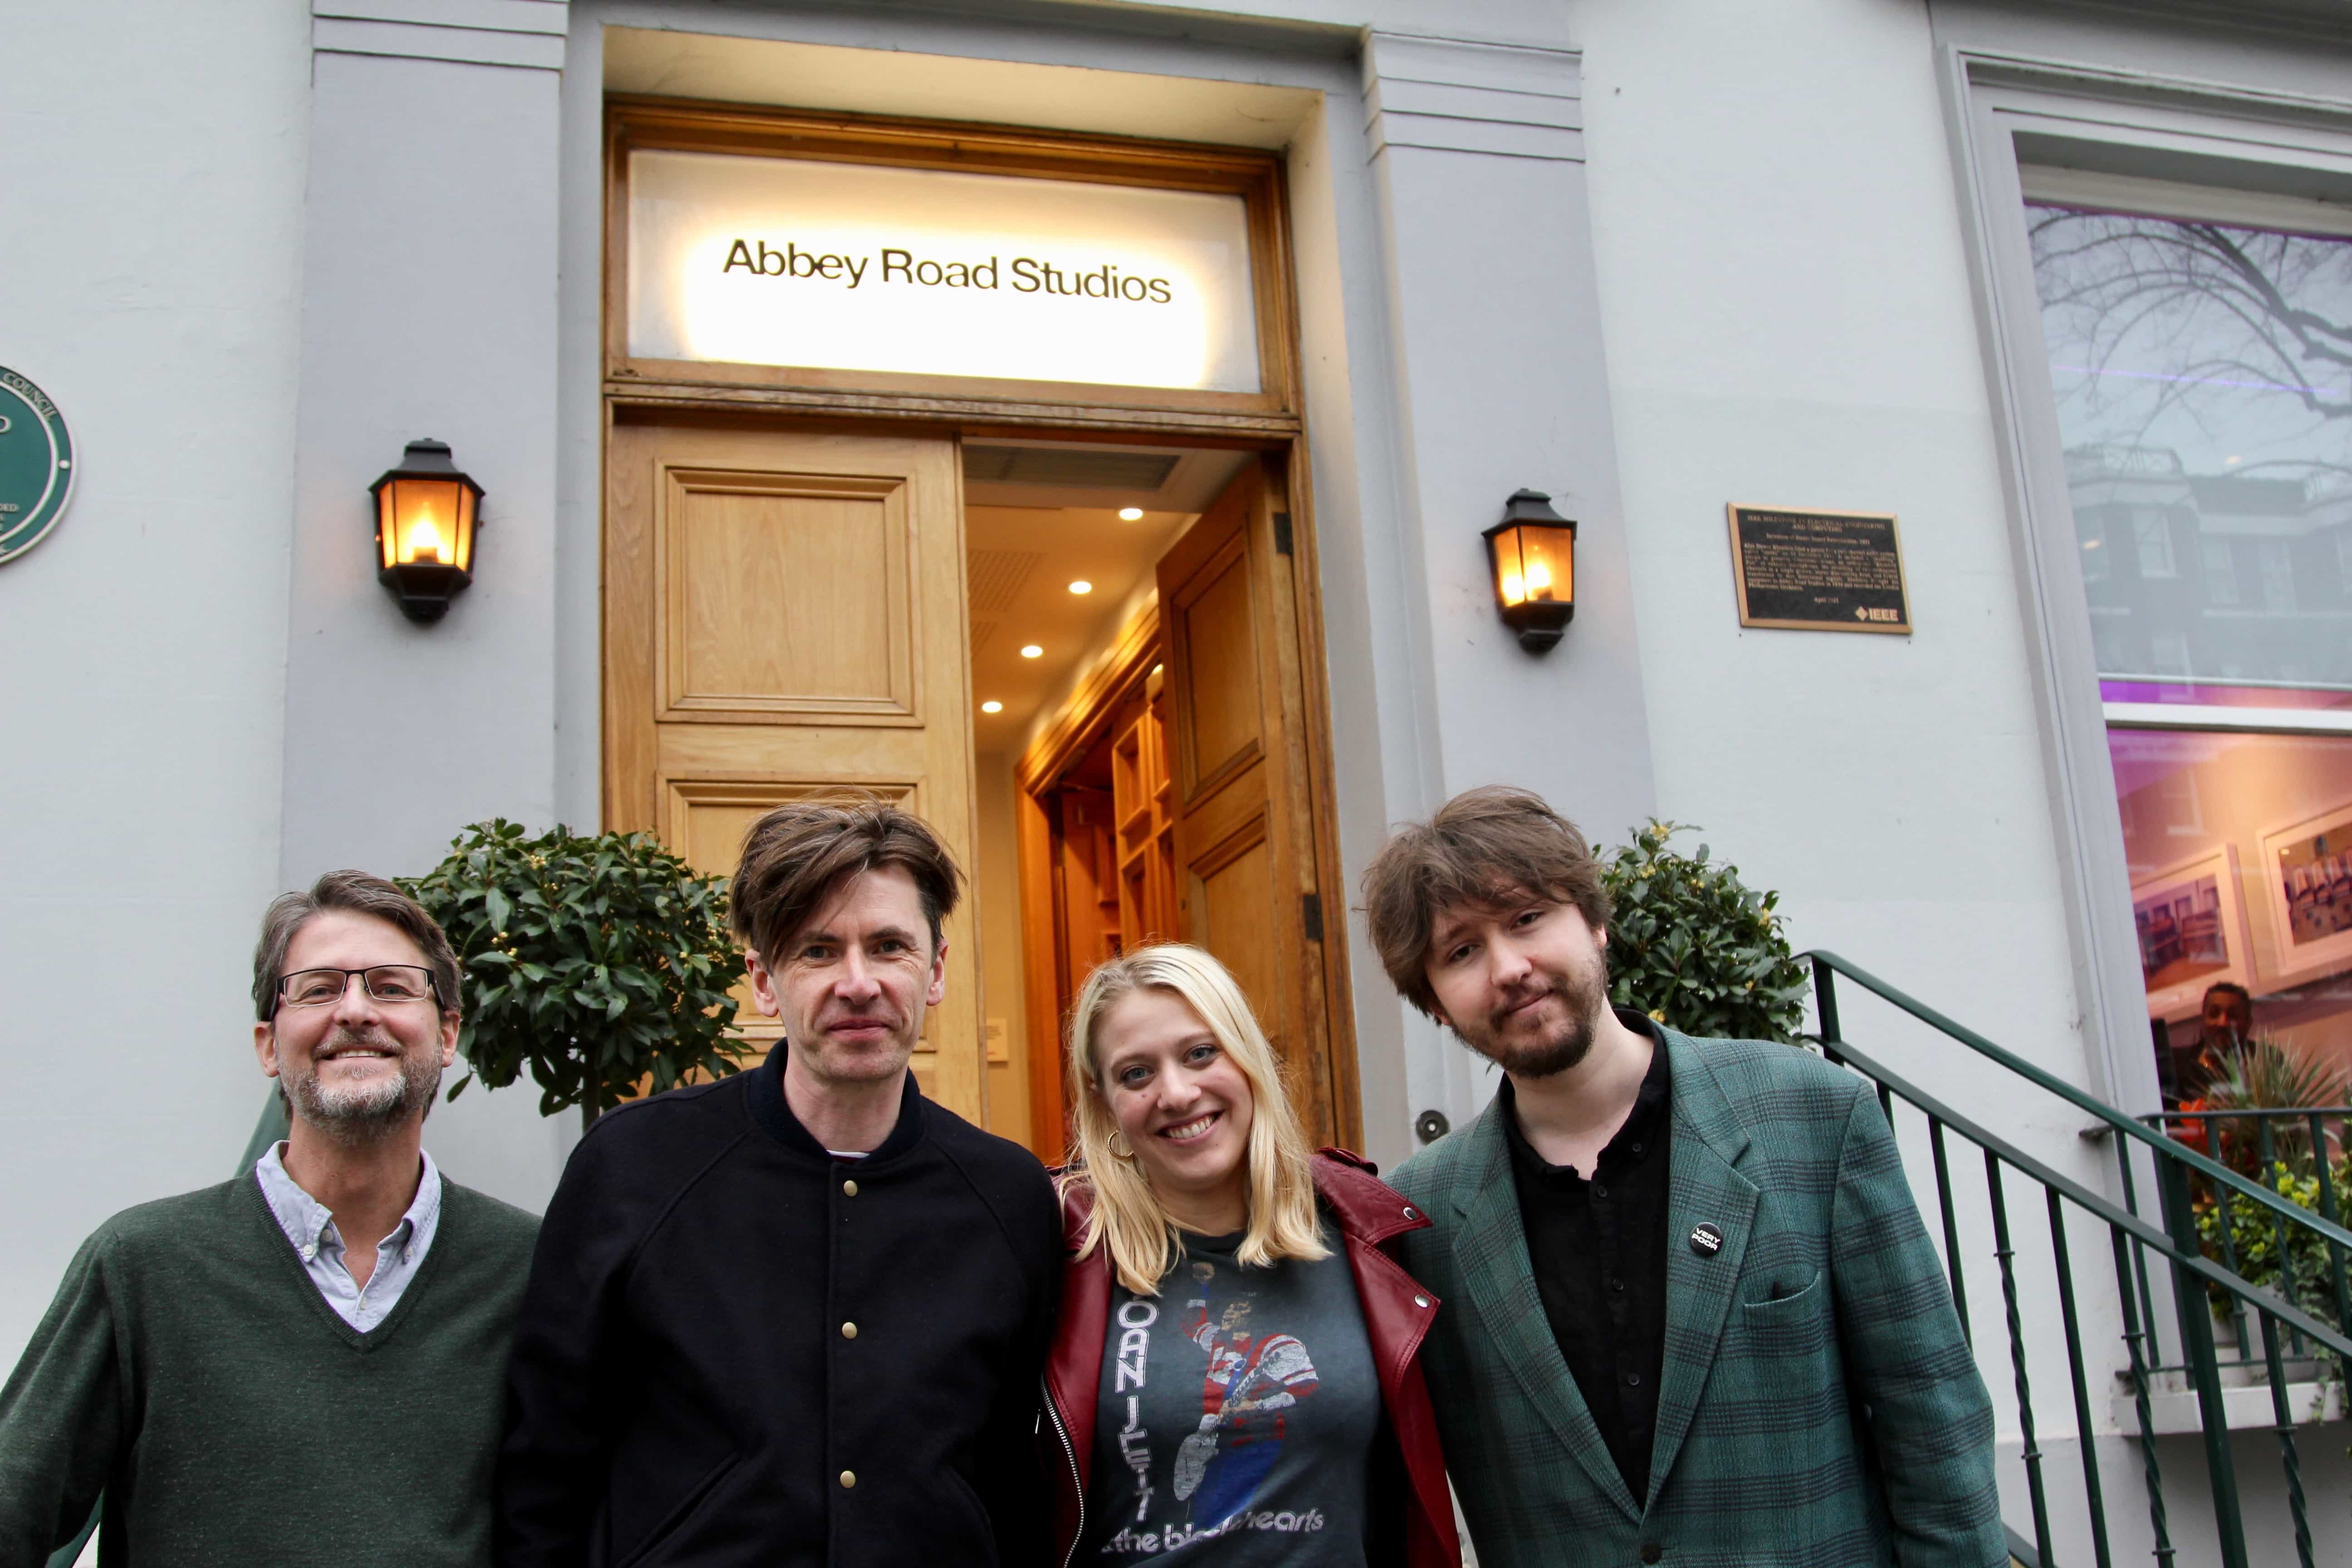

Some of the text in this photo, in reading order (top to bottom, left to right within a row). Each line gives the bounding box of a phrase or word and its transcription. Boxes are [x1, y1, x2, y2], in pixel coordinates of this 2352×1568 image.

[723, 239, 1171, 304] Abbey Road Studios
[3, 372, 57, 418] COUNCIL
[1868, 608, 1898, 622] IEEE
[1691, 1233, 1718, 1251] POOR
[1696, 1228, 1720, 1244] VERY
[1115, 1296, 1159, 1393] OAN
